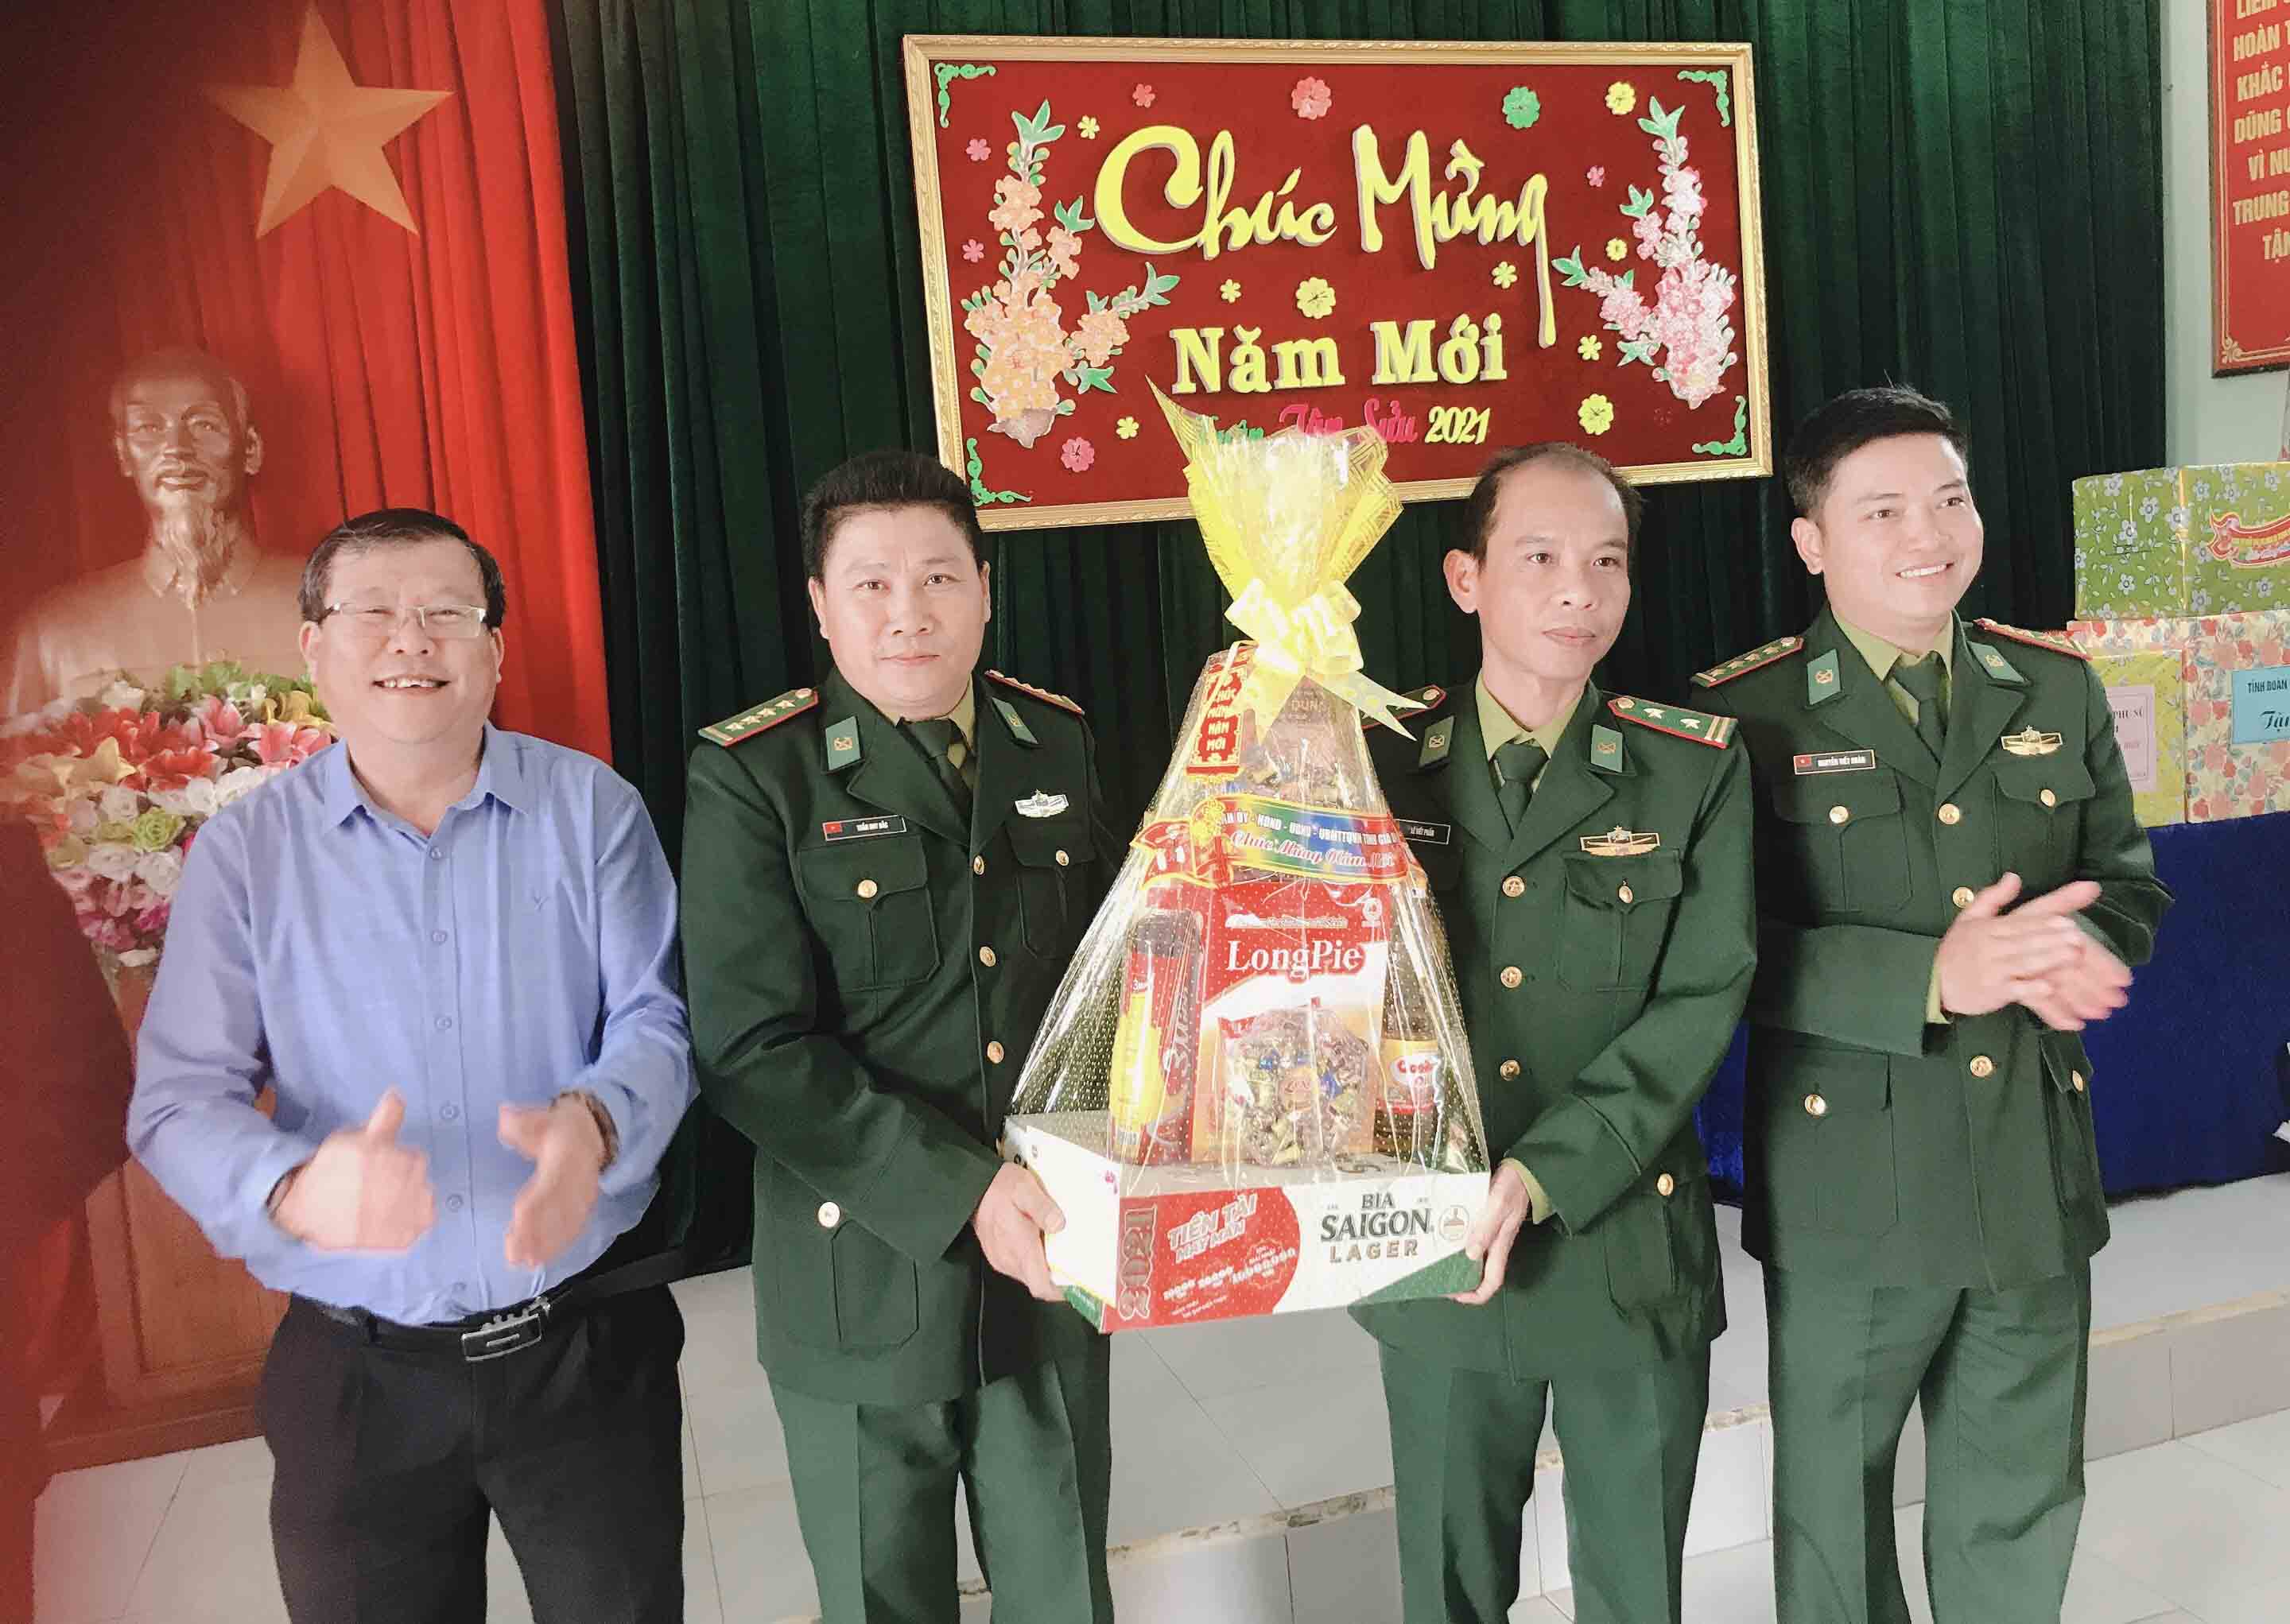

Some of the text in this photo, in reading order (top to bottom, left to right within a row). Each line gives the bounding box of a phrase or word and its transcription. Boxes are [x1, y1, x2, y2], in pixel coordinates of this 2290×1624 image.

[2234, 23, 2280, 61] HOÀN
[2237, 61, 2284, 102] KHẮC
[2248, 148, 2265, 181] VÌ
[2233, 190, 2289, 226] TRUNG
[1094, 123, 1556, 348] Chúc Mừng
[1169, 312, 1508, 394] Năm Mới
[1424, 405, 1491, 444] 2021
[1226, 940, 1362, 979] LongPie
[1361, 1192, 1395, 1209] BIA
[1320, 1207, 1433, 1242] SAIGON
[1329, 1238, 1419, 1263] LAGER
